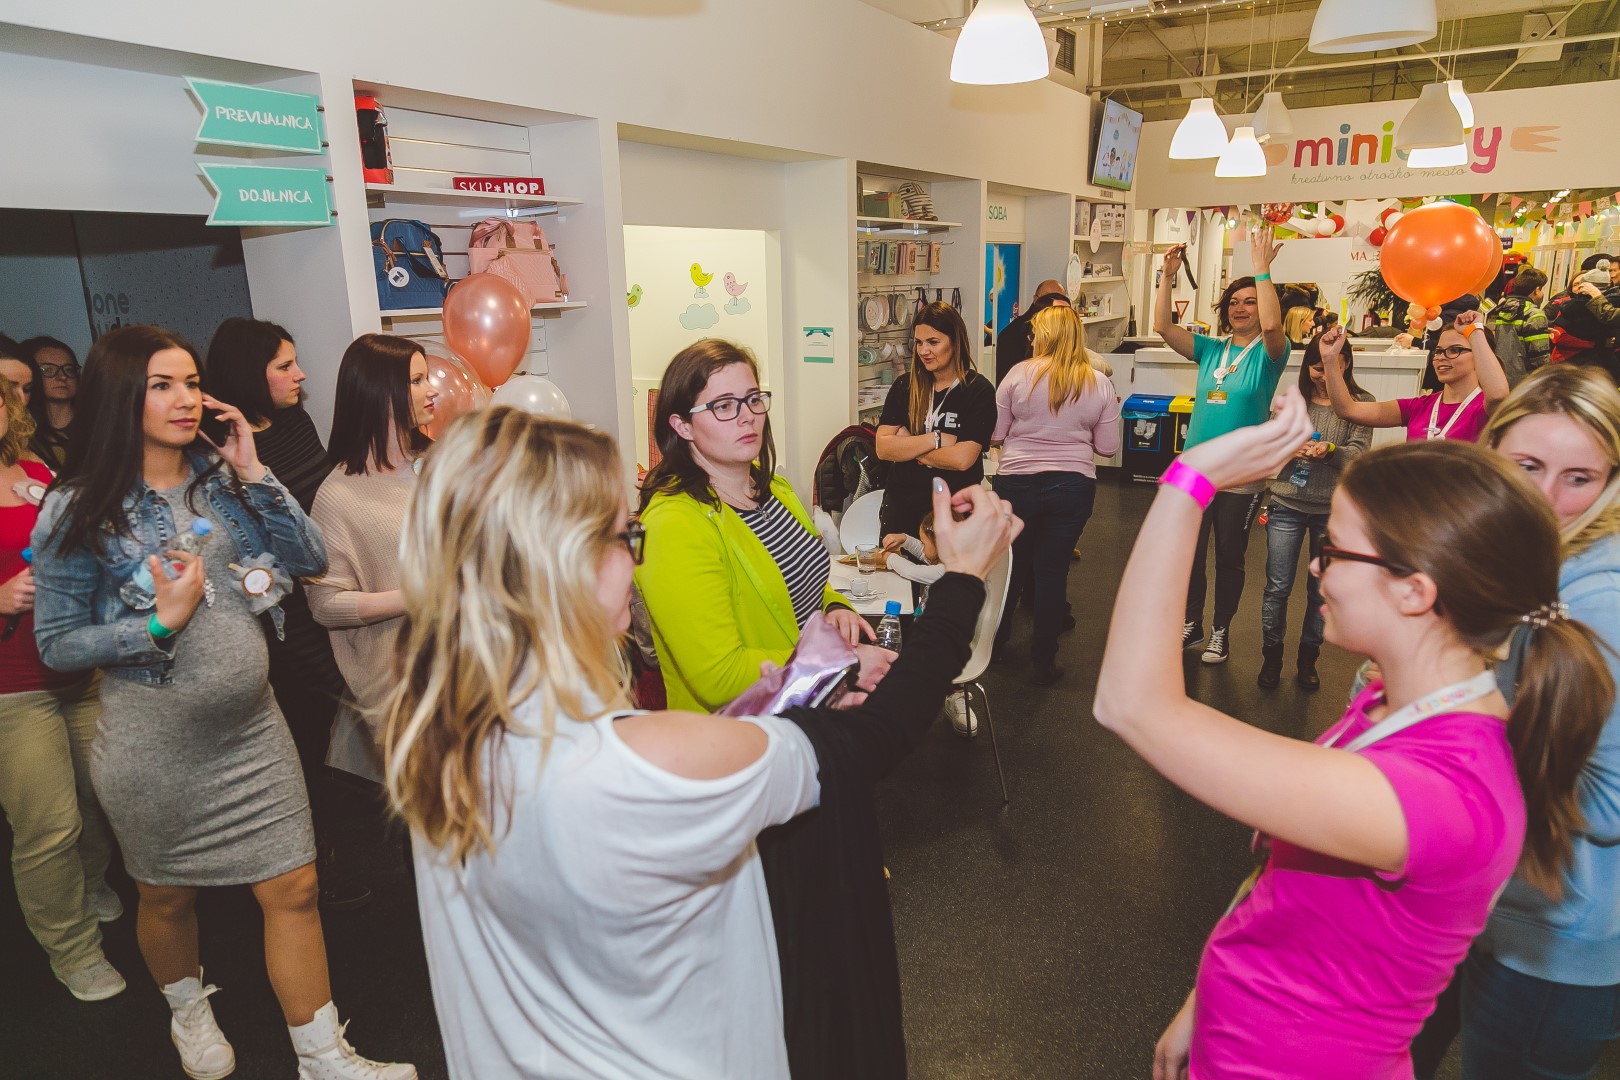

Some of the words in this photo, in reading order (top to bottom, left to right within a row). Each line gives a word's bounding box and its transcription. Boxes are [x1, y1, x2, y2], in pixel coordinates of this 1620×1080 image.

[215, 105, 313, 130] PREVIJALNICA
[1294, 120, 1502, 174] miniy
[1291, 172, 1354, 184] kreativno
[1360, 167, 1413, 181] otroško
[1421, 165, 1467, 178] mesto
[239, 188, 312, 203] DOJILNICA
[988, 205, 1008, 221] SOBA
